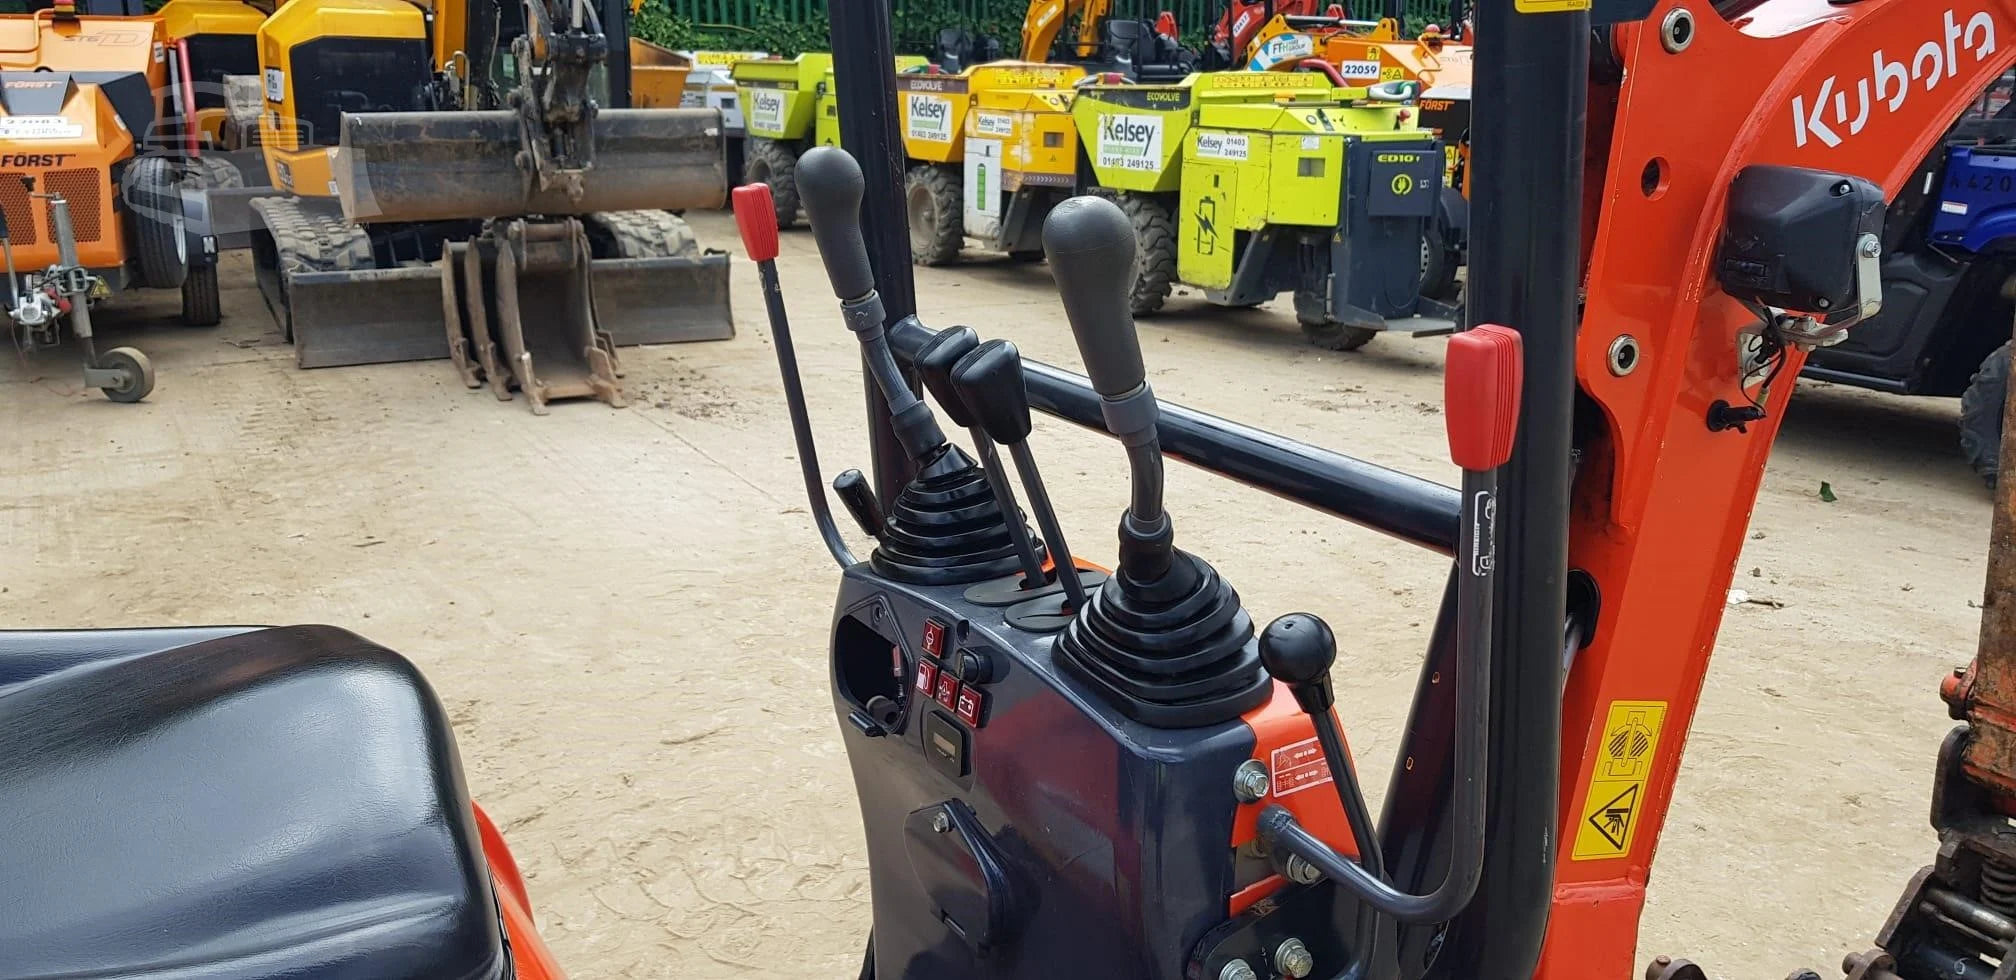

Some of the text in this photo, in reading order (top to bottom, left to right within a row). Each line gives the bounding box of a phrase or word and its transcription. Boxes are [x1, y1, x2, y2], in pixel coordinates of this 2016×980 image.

[1344, 65, 1377, 75] 22059
[1792, 9, 1996, 149] Kubota
[1147, 92, 1180, 101] ECOVOLVE
[911, 96, 946, 131] Kelsey
[979, 116, 994, 130] Kelsey
[1103, 115, 1155, 157] Kelsey
[1197, 135, 1223, 154] Kelsey
[1226, 138, 1245, 147] 01403
[1224, 148, 1247, 158] 249125
[1127, 159, 1154, 169] 249125
